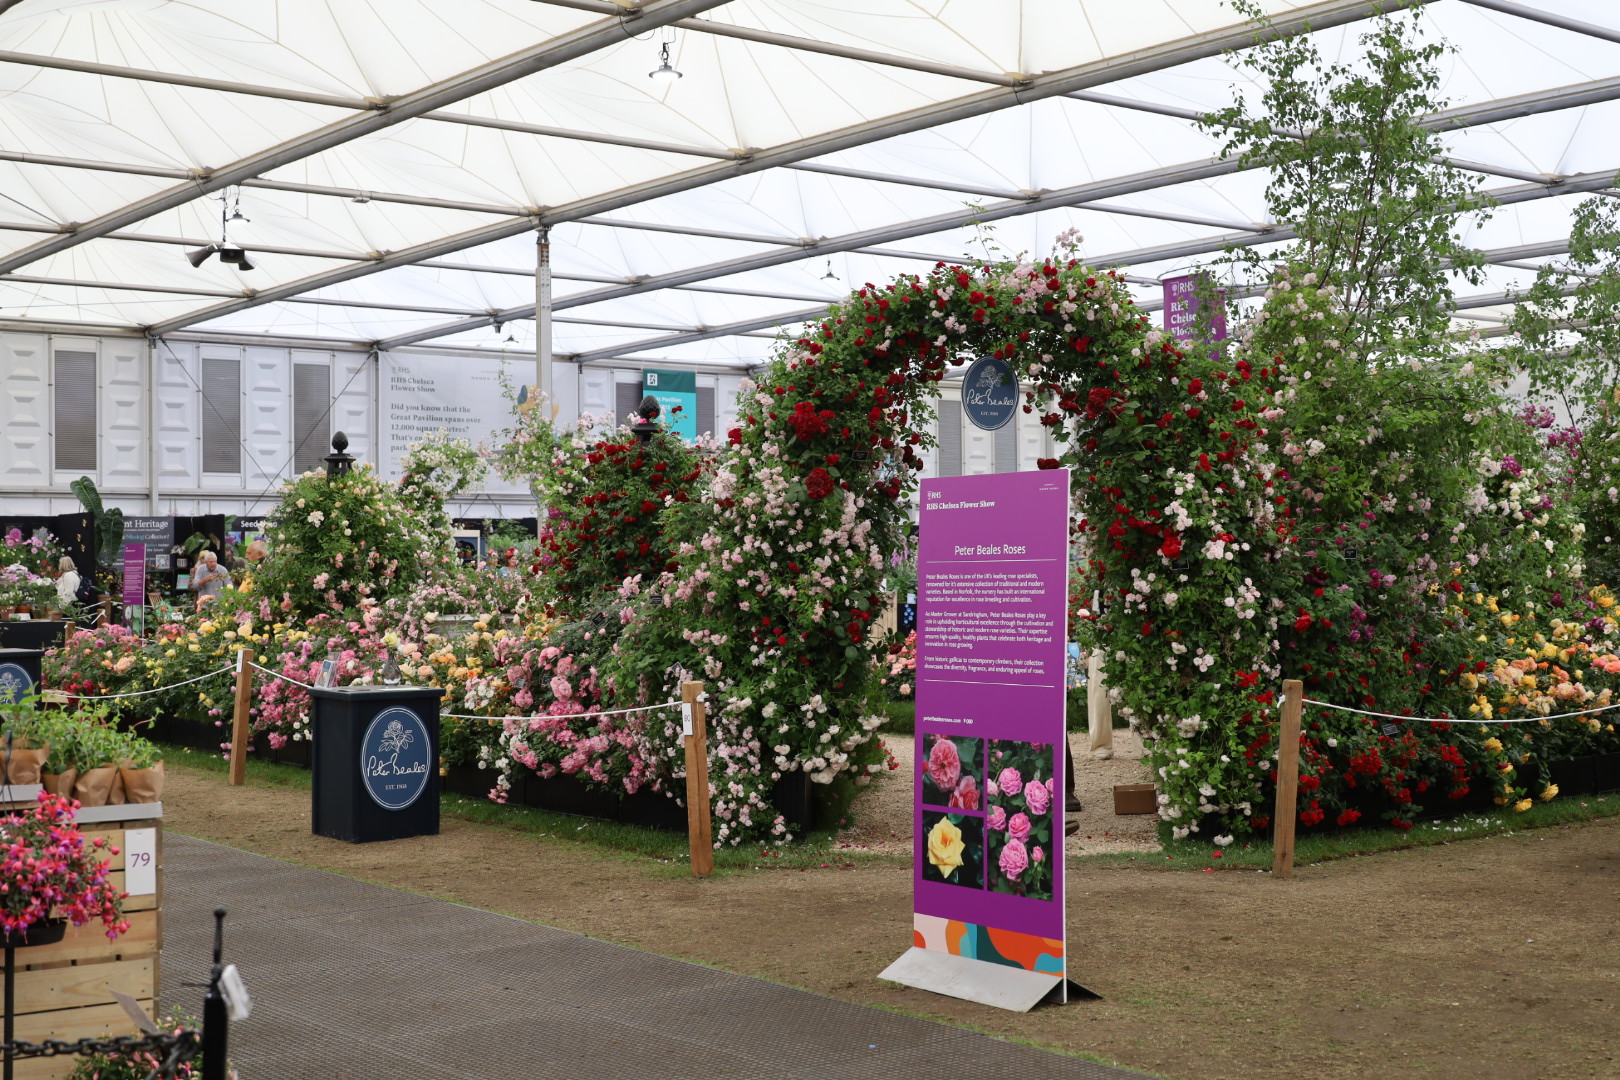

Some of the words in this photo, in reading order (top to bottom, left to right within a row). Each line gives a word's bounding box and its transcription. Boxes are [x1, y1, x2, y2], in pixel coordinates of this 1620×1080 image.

[1180, 281, 1195, 292] RHS
[1171, 313, 1196, 324] Chelse
[408, 377, 434, 385] Chelsea
[413, 414, 443, 422] Pavilion
[444, 416, 464, 424] spans
[932, 491, 942, 499] RHS
[135, 520, 168, 529] Heritage
[954, 545, 975, 556] Peter
[977, 544, 1001, 555] Beales
[1003, 543, 1026, 554] Roses
[996, 666, 1013, 674] enduring
[367, 756, 390, 777] Peter
[390, 752, 426, 776] Beales
[130, 852, 150, 868] 79
